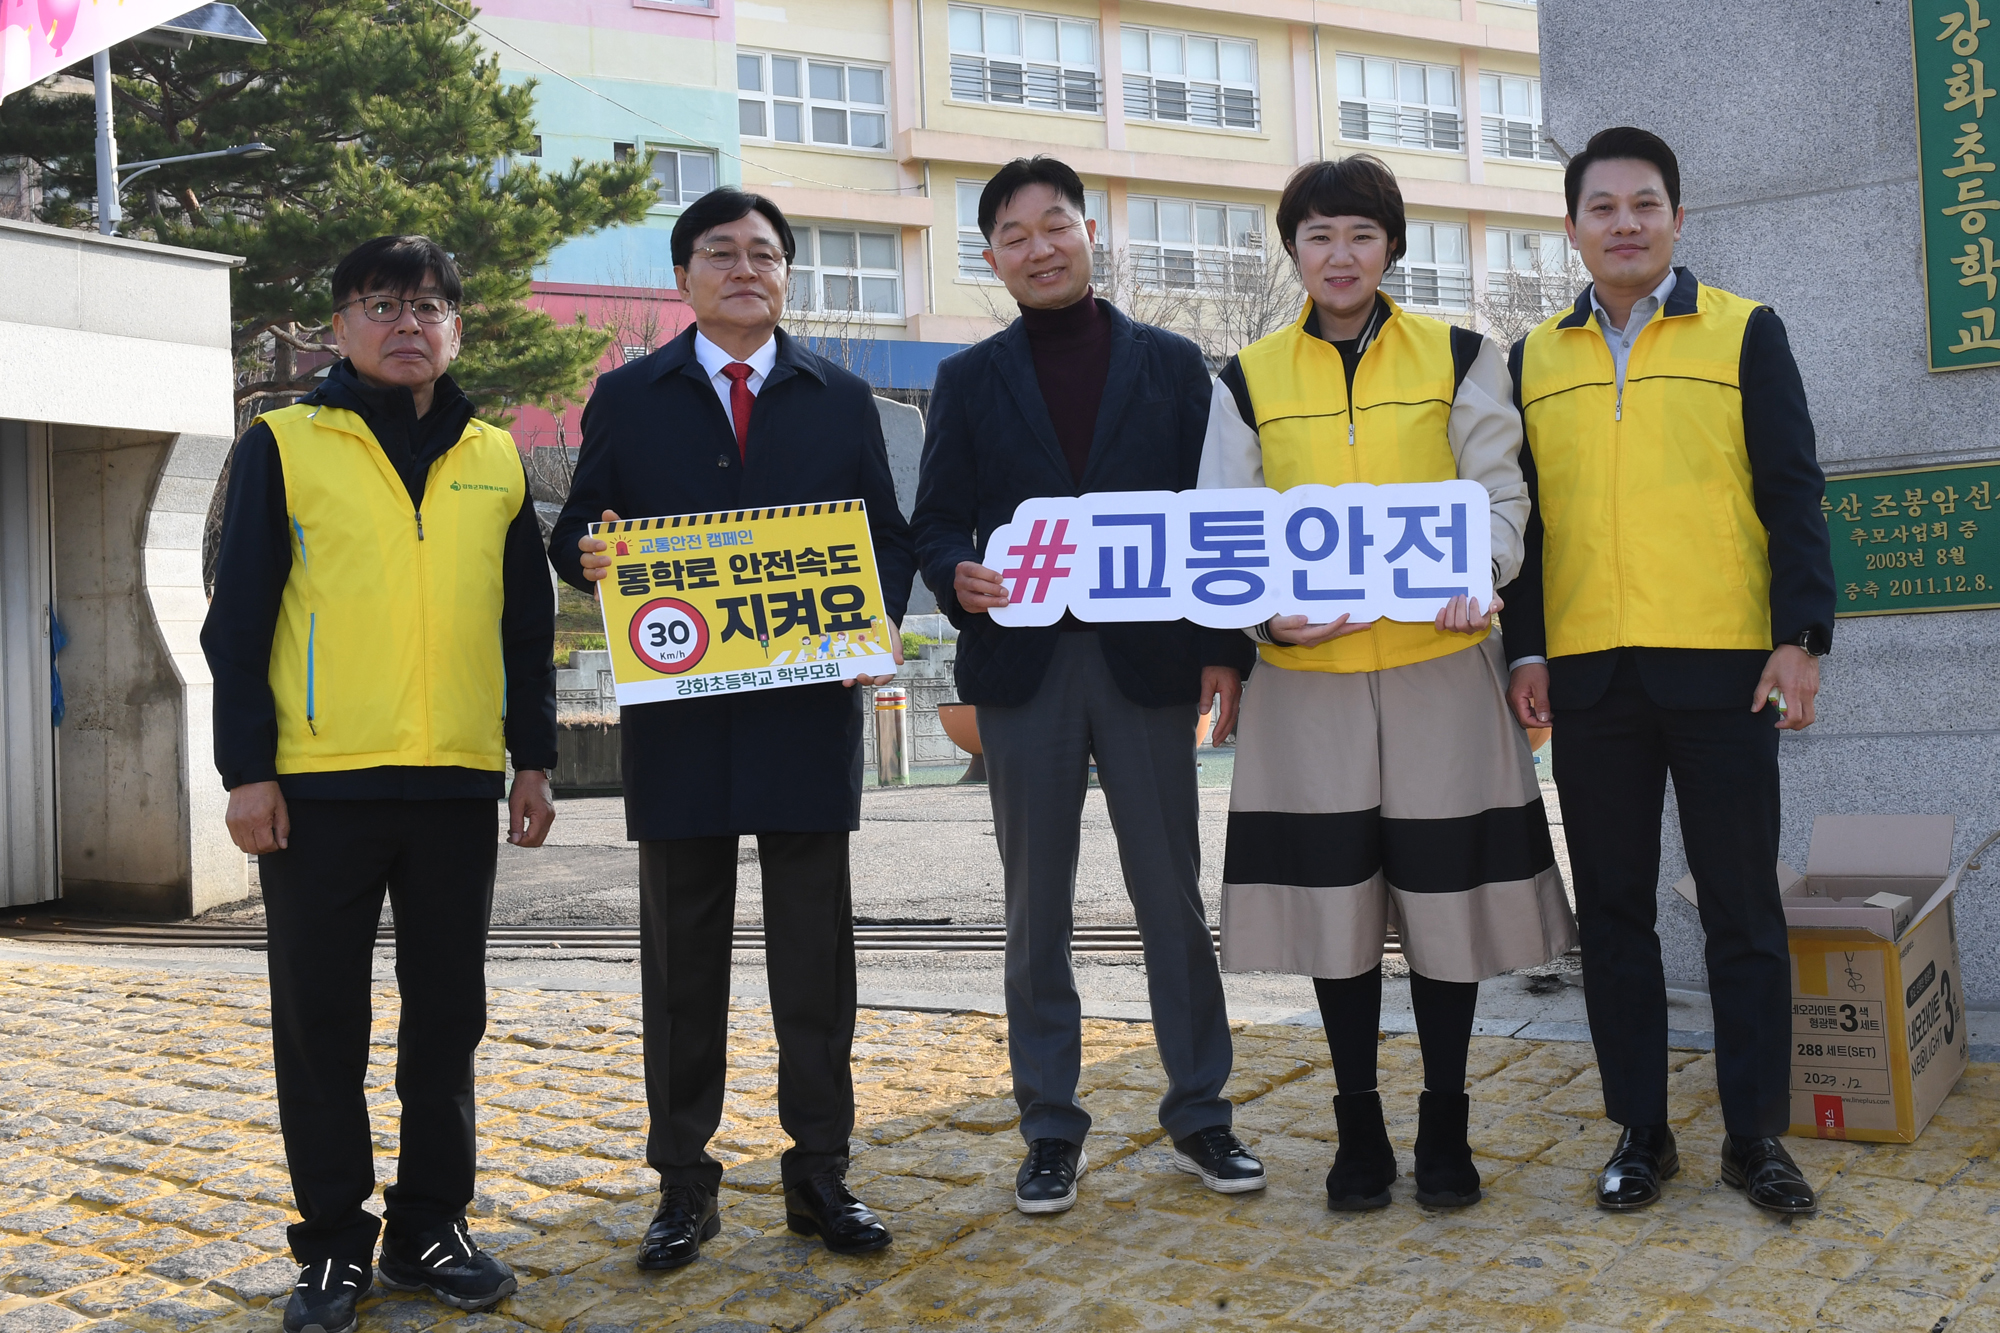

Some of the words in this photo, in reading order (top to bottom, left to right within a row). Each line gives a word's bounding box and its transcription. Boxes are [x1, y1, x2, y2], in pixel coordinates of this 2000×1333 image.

[1936, 0, 2000, 354] 강화초등학교
[1964, 481, 2000, 511] 선
[639, 534, 703, 555] 교통안전
[706, 530, 754, 548] 캠페인
[1850, 521, 1948, 547] 추모사업회
[1958, 520, 1979, 540] 증
[616, 557, 720, 597] 통학로
[728, 543, 862, 586] 안전속도
[1865, 549, 1925, 570] 2003년
[1936, 546, 1966, 566] 8월
[1844, 580, 1880, 601] 증축
[1889, 574, 1994, 597] 2011.12.8.
[715, 584, 872, 644] 지켜요
[647, 620, 690, 647] 30
[660, 650, 685, 660] Km/h
[676, 670, 774, 697] 강화초등학교
[776, 662, 842, 685] 학부모회
[1809, 1017, 1838, 1030] 형광펜
[1860, 1019, 1880, 1031] 세트
[1839, 1003, 1859, 1032] 3
[1859, 1006, 1869, 1018] 색
[1908, 990, 1941, 1052] 네오라이트
[1940, 969, 1955, 1046] 3
[1797, 1043, 1823, 1057] 288
[1826, 1045, 1876, 1059] 세트(SET)
